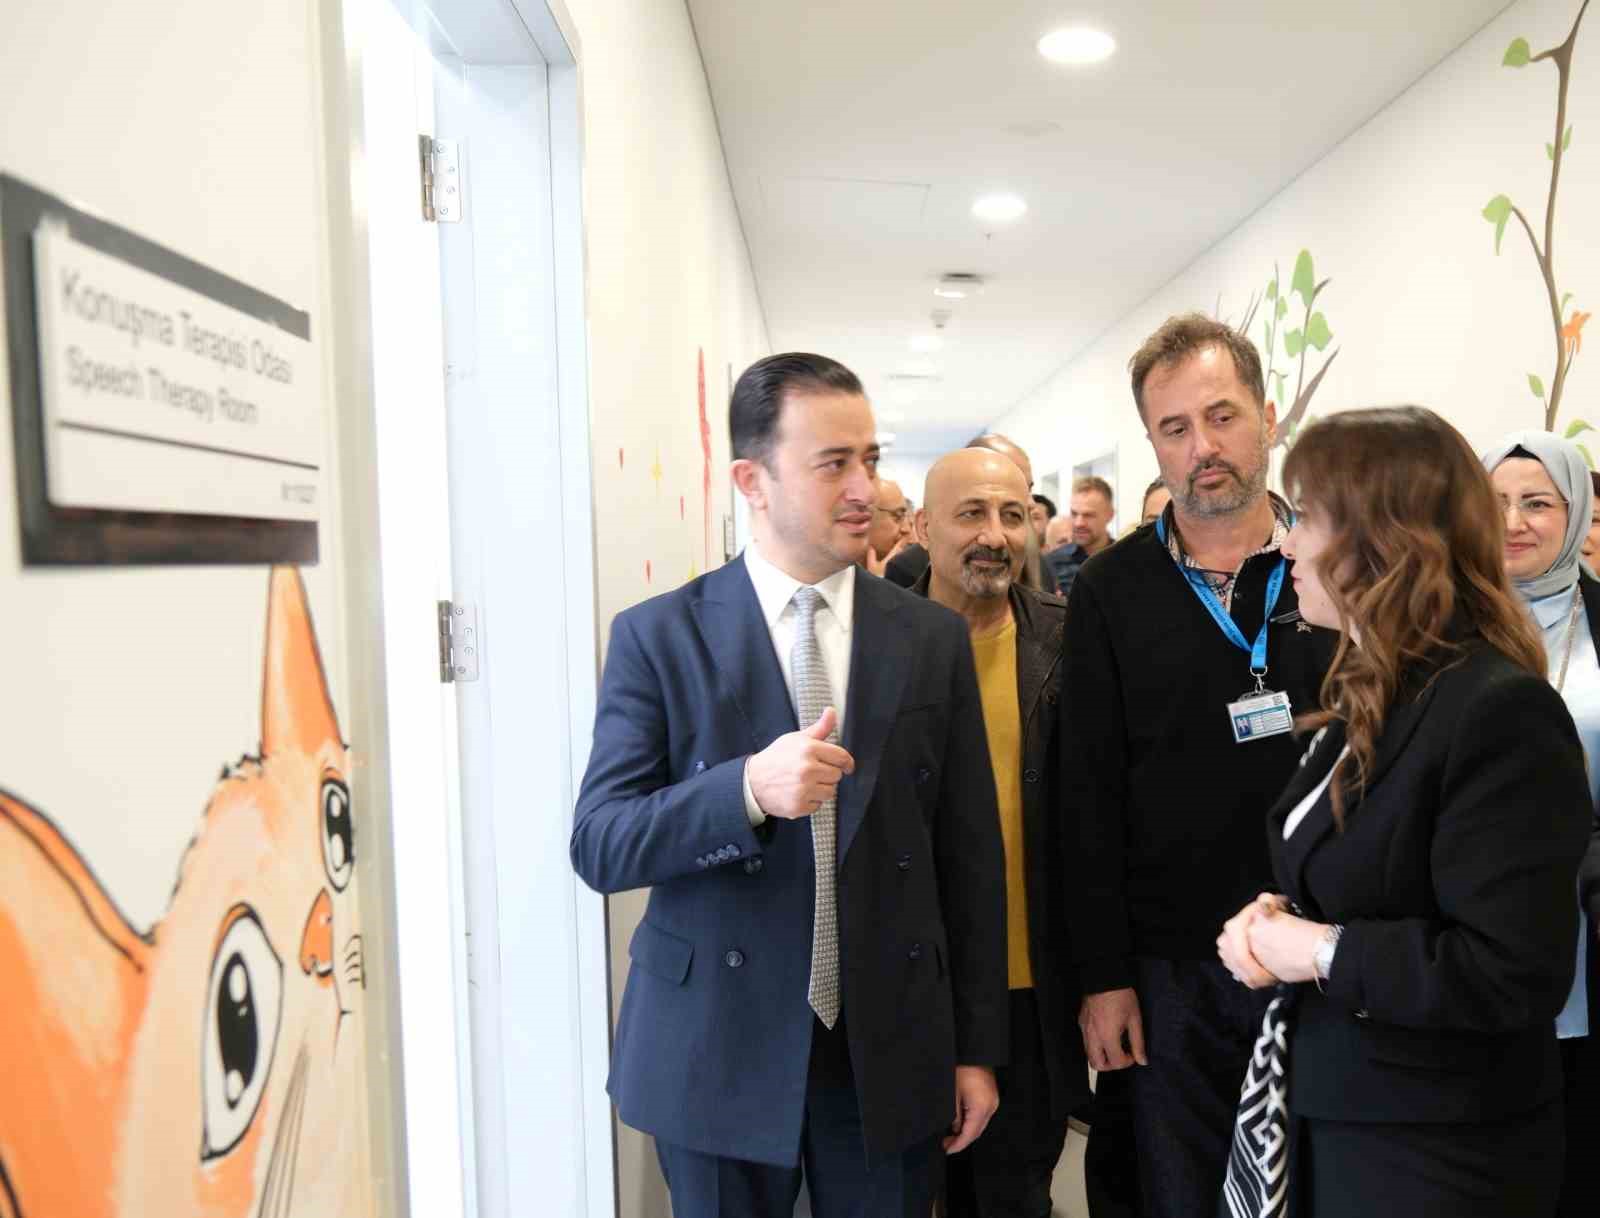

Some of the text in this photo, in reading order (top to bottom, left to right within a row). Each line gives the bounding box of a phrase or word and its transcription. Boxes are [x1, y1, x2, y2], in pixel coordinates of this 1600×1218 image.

[60, 266, 174, 349] Konuşma
[178, 309, 248, 370] Terapisi
[65, 345, 258, 424] Speech Therapy Room
